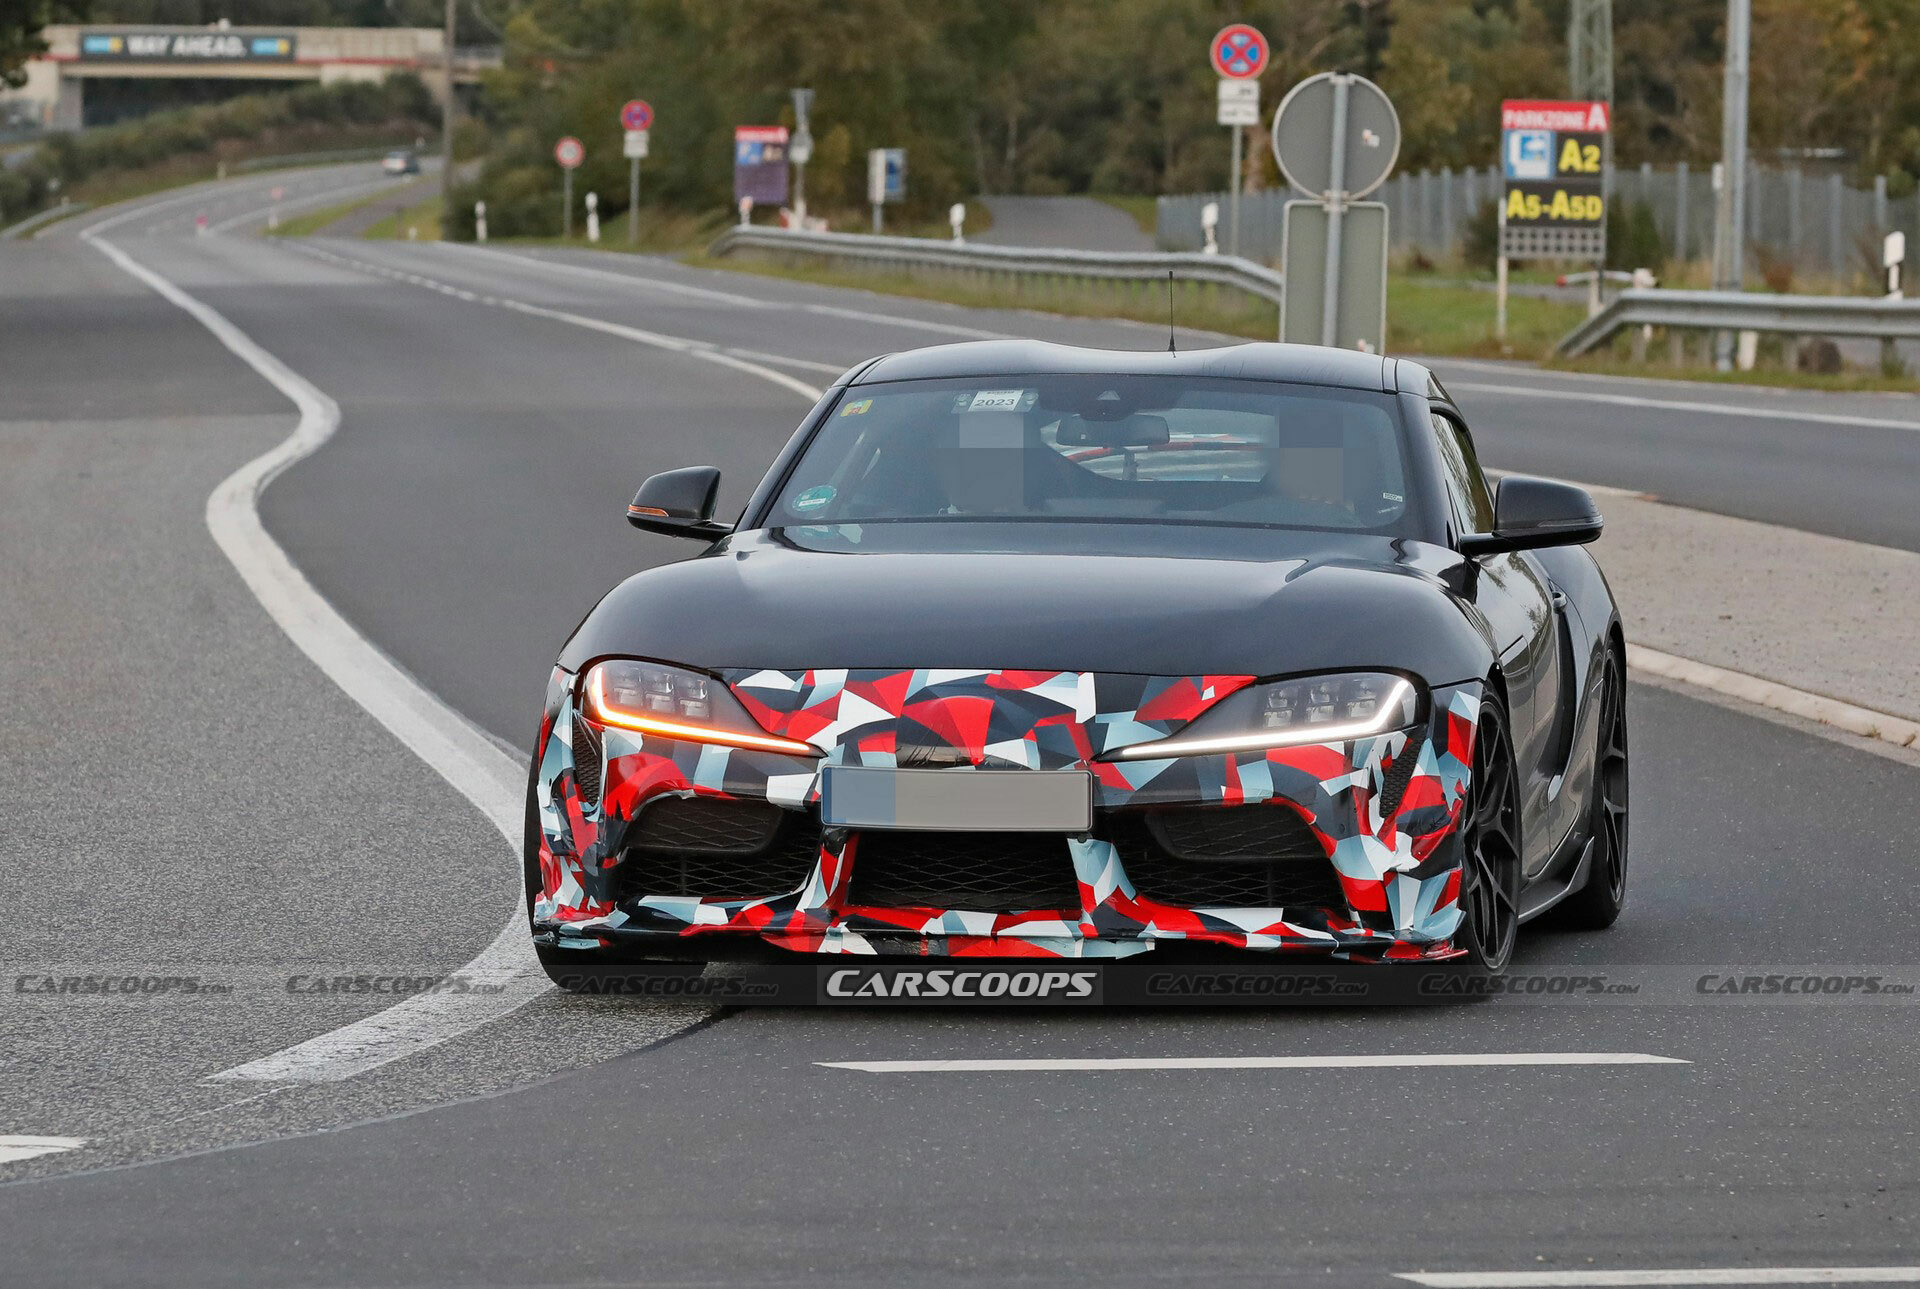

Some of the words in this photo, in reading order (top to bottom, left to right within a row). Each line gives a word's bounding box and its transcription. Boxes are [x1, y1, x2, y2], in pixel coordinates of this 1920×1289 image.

[126, 35, 170, 56] WAY
[1503, 110, 1585, 128] PARKZONE
[1588, 103, 1607, 129] A
[1558, 138, 1601, 172] A2
[974, 398, 1015, 407] 2023
